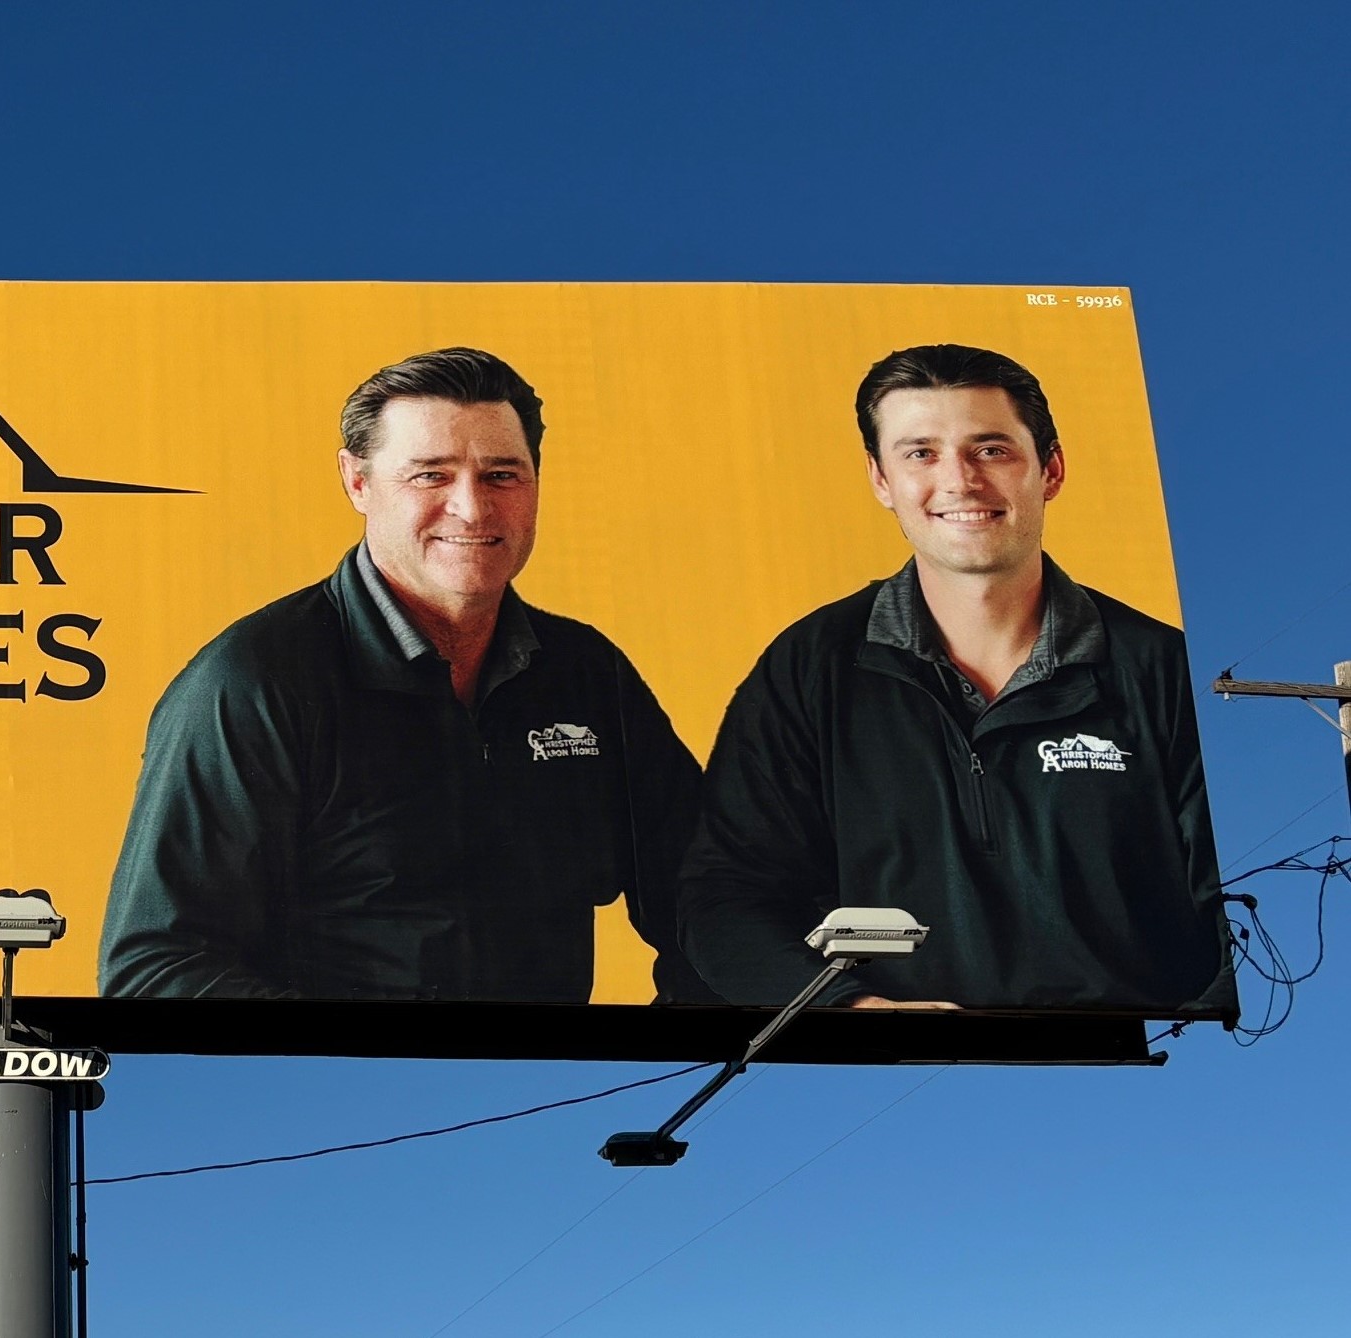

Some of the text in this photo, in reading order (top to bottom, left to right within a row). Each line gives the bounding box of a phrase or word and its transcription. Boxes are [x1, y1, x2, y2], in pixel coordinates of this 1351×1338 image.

[1026, 294, 1058, 305] RCE
[1076, 295, 1122, 308] 59936
[1091, 760, 1127, 771] HOMES
